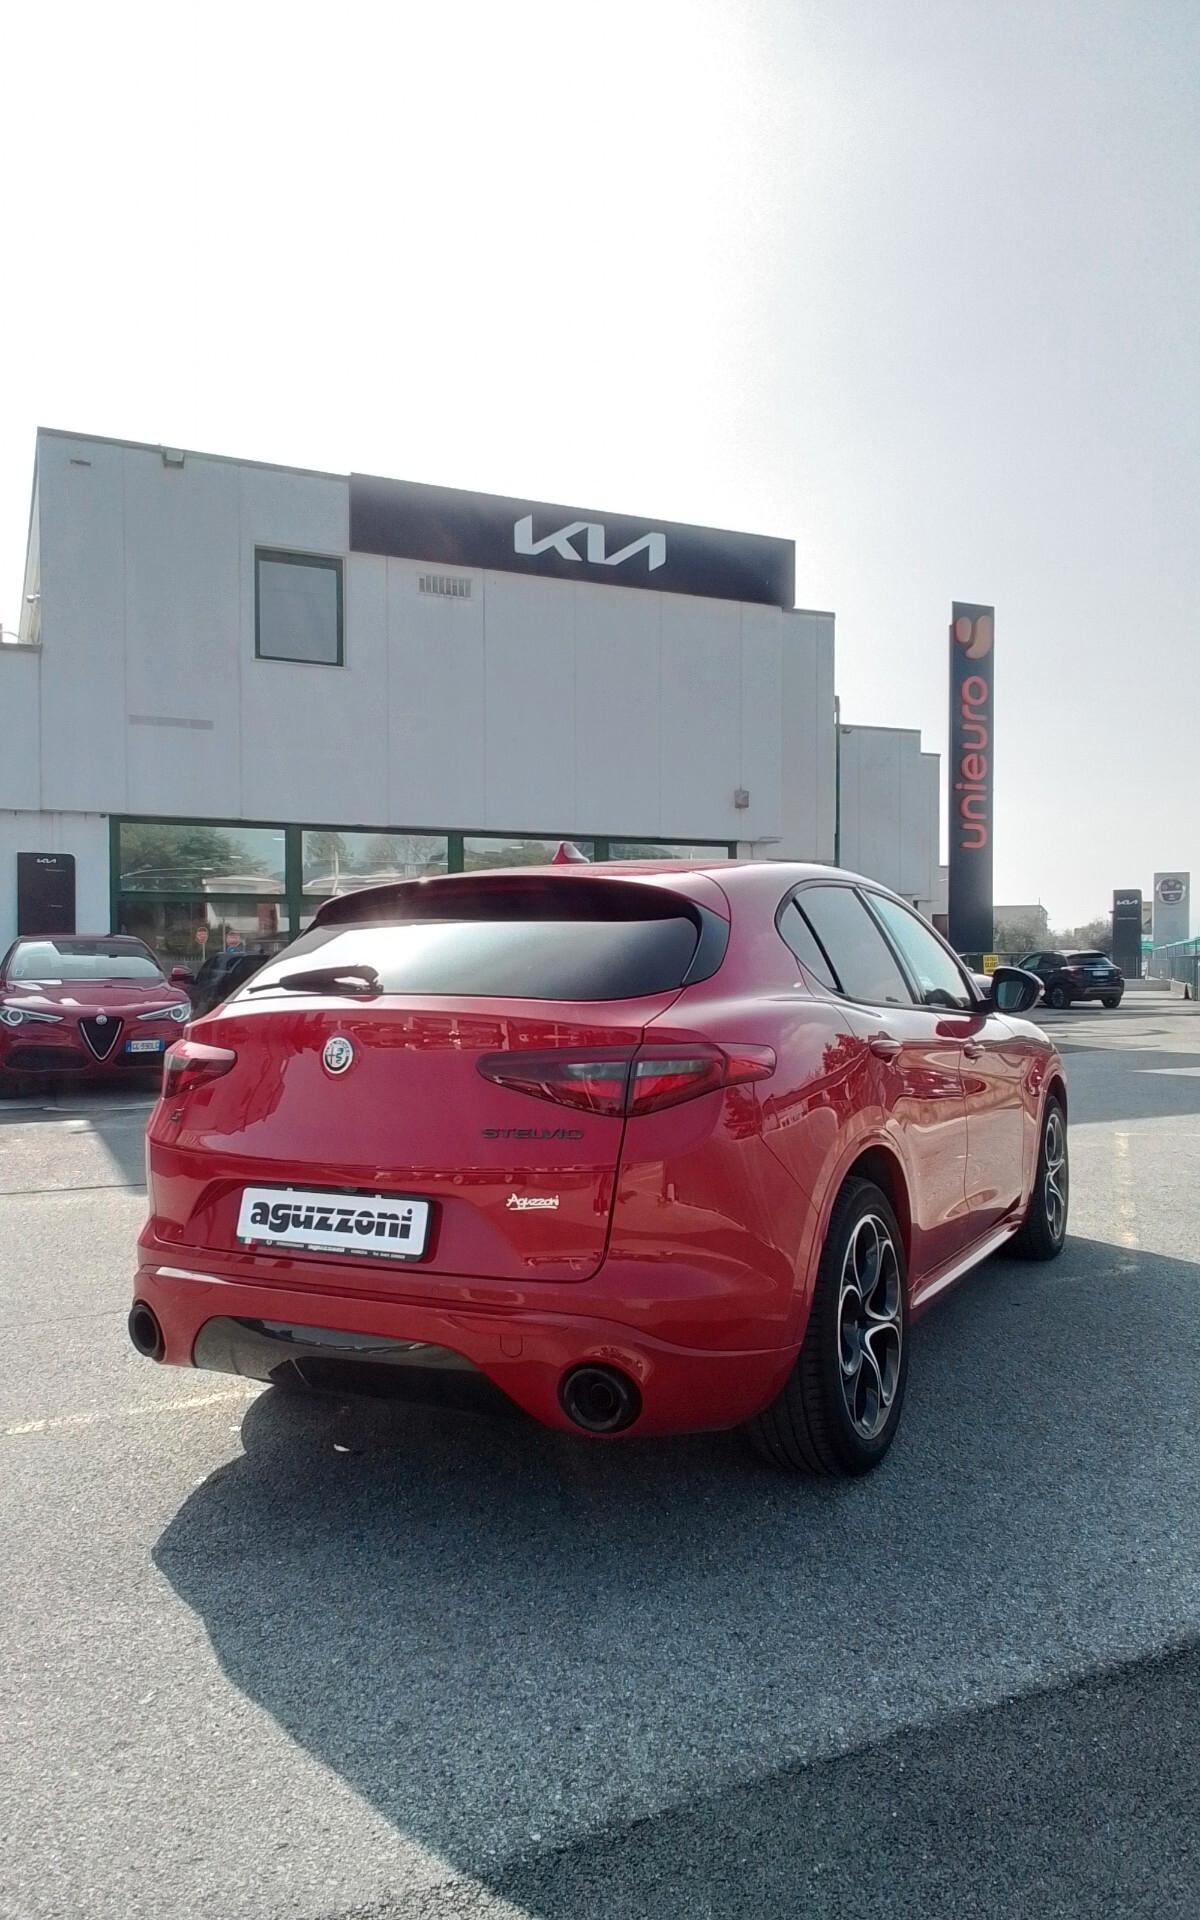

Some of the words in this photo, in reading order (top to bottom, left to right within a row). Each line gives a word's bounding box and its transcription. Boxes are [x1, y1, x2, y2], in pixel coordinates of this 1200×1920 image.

[514, 513, 667, 572] KIA
[954, 675, 988, 850] unieuro
[481, 1128, 584, 1140] STELVIO
[250, 1201, 413, 1240] aguzzoni
[506, 1193, 560, 1211] Aguzzoni
